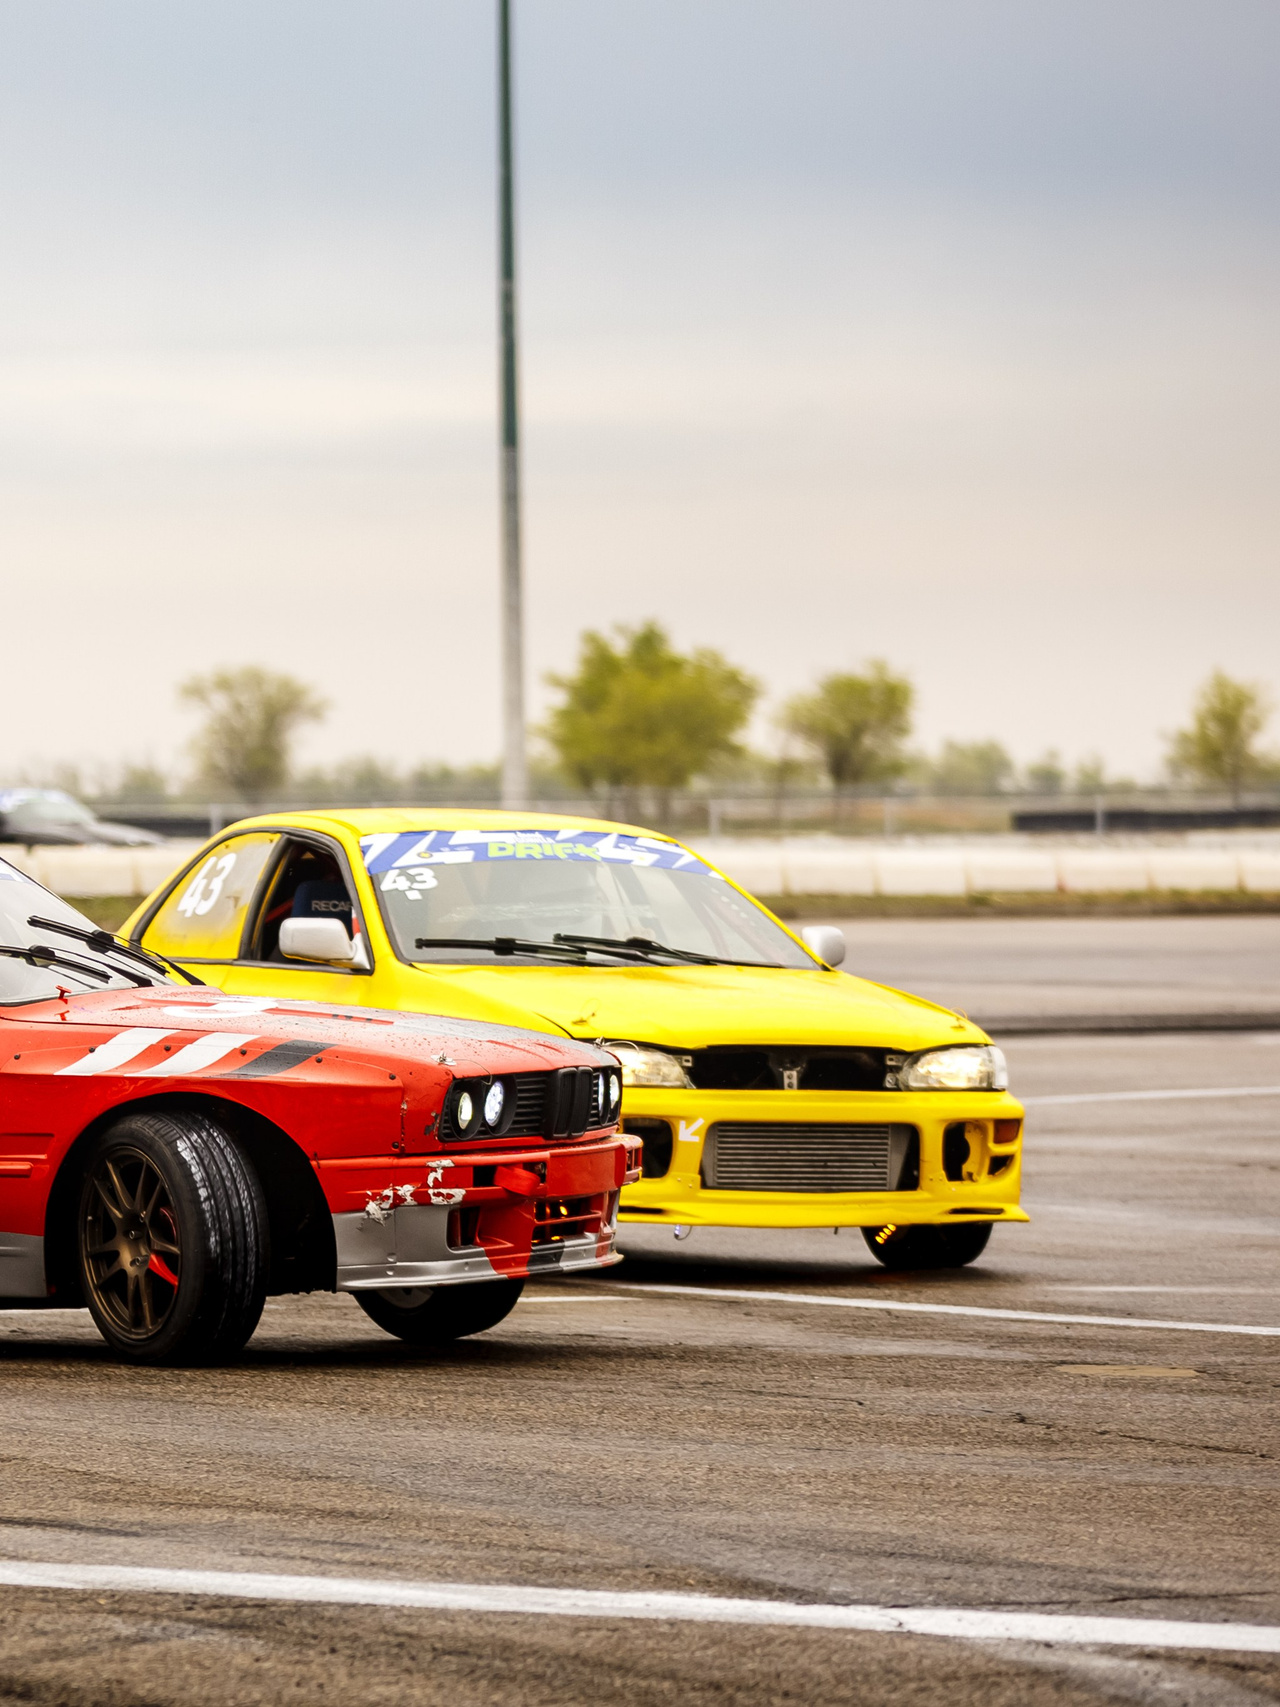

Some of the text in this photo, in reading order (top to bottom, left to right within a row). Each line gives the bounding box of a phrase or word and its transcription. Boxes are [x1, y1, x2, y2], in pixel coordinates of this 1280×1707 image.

[488, 842, 602, 861] DRIFT
[177, 853, 237, 917] 43
[380, 867, 439, 892] 43
